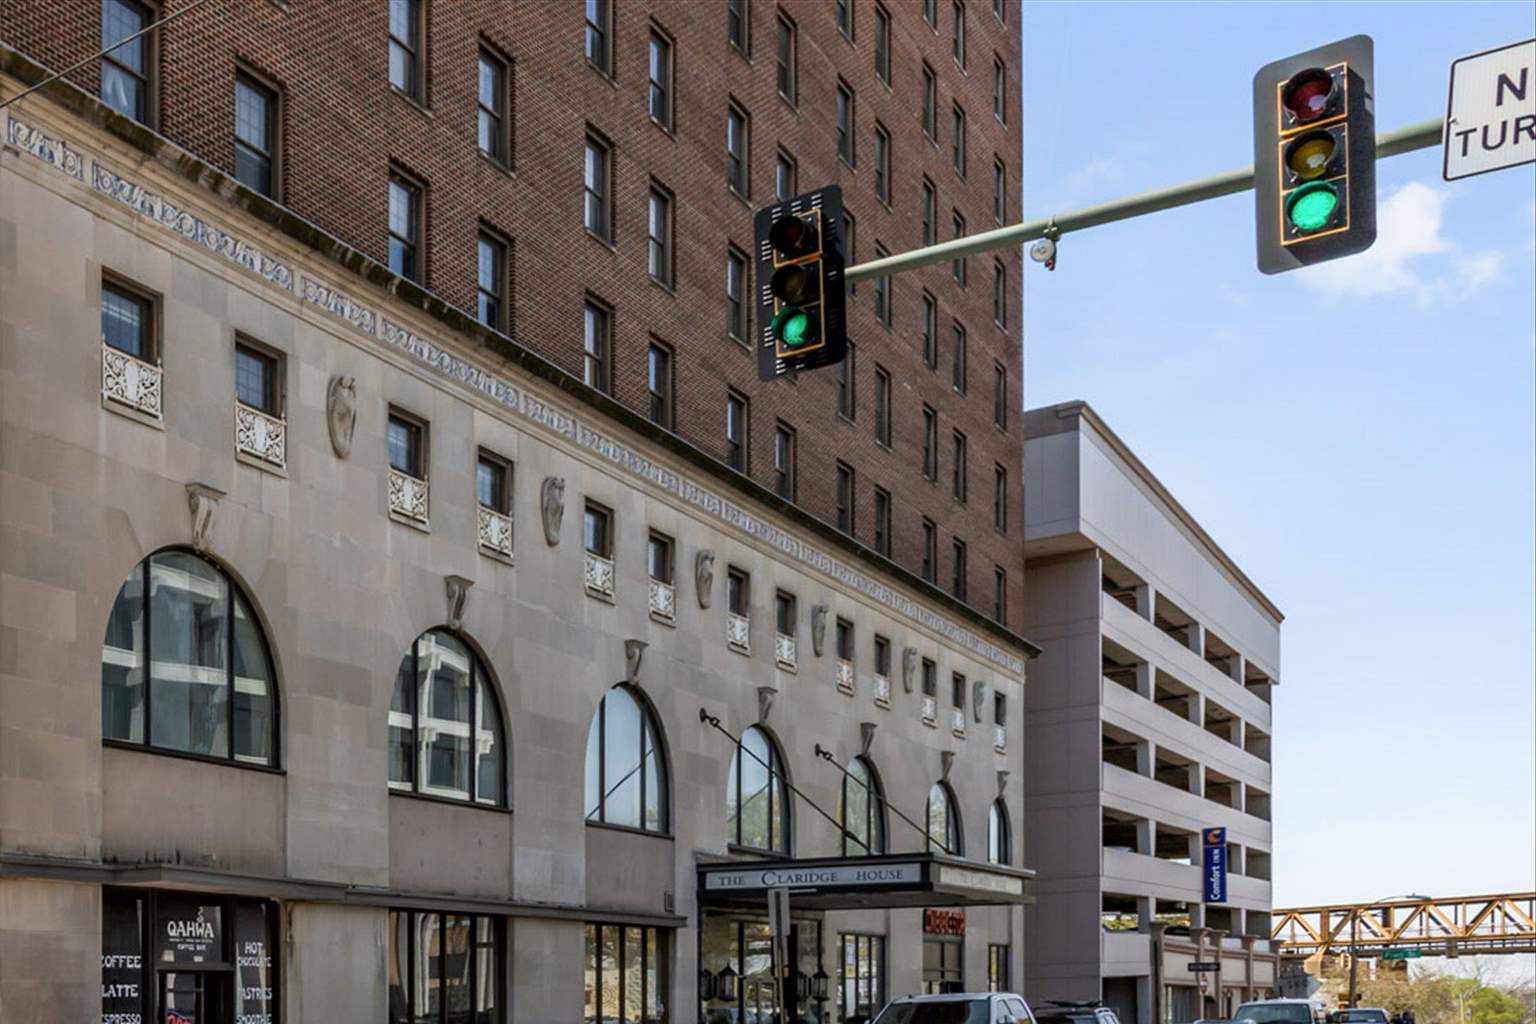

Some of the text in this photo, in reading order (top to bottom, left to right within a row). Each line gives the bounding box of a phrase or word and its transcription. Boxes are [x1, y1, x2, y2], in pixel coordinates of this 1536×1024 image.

[718, 875, 745, 886] THE
[856, 869, 904, 881] HOUSE
[1210, 866, 1221, 900] Comfort
[167, 920, 214, 938] QAHWA
[245, 942, 263, 954] HOT
[102, 984, 139, 998] LATTE
